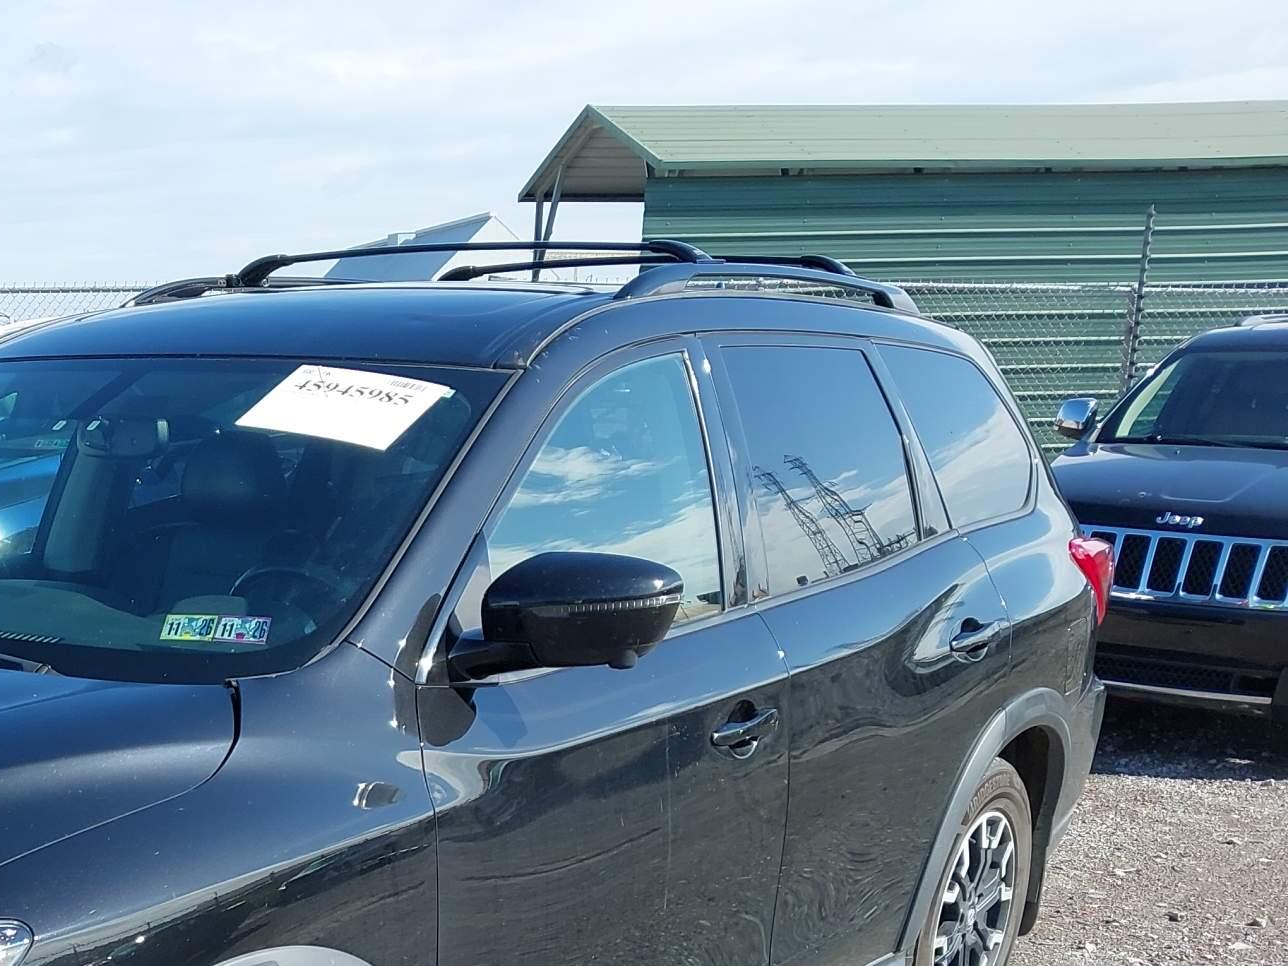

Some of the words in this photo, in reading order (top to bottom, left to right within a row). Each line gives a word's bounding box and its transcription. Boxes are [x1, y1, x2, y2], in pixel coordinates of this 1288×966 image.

[294, 379, 415, 406] 45945985
[1156, 511, 1204, 529] Jeep
[167, 621, 182, 636] 11
[198, 619, 214, 636] 26
[220, 622, 236, 637] 11
[252, 620, 267, 639] 26
